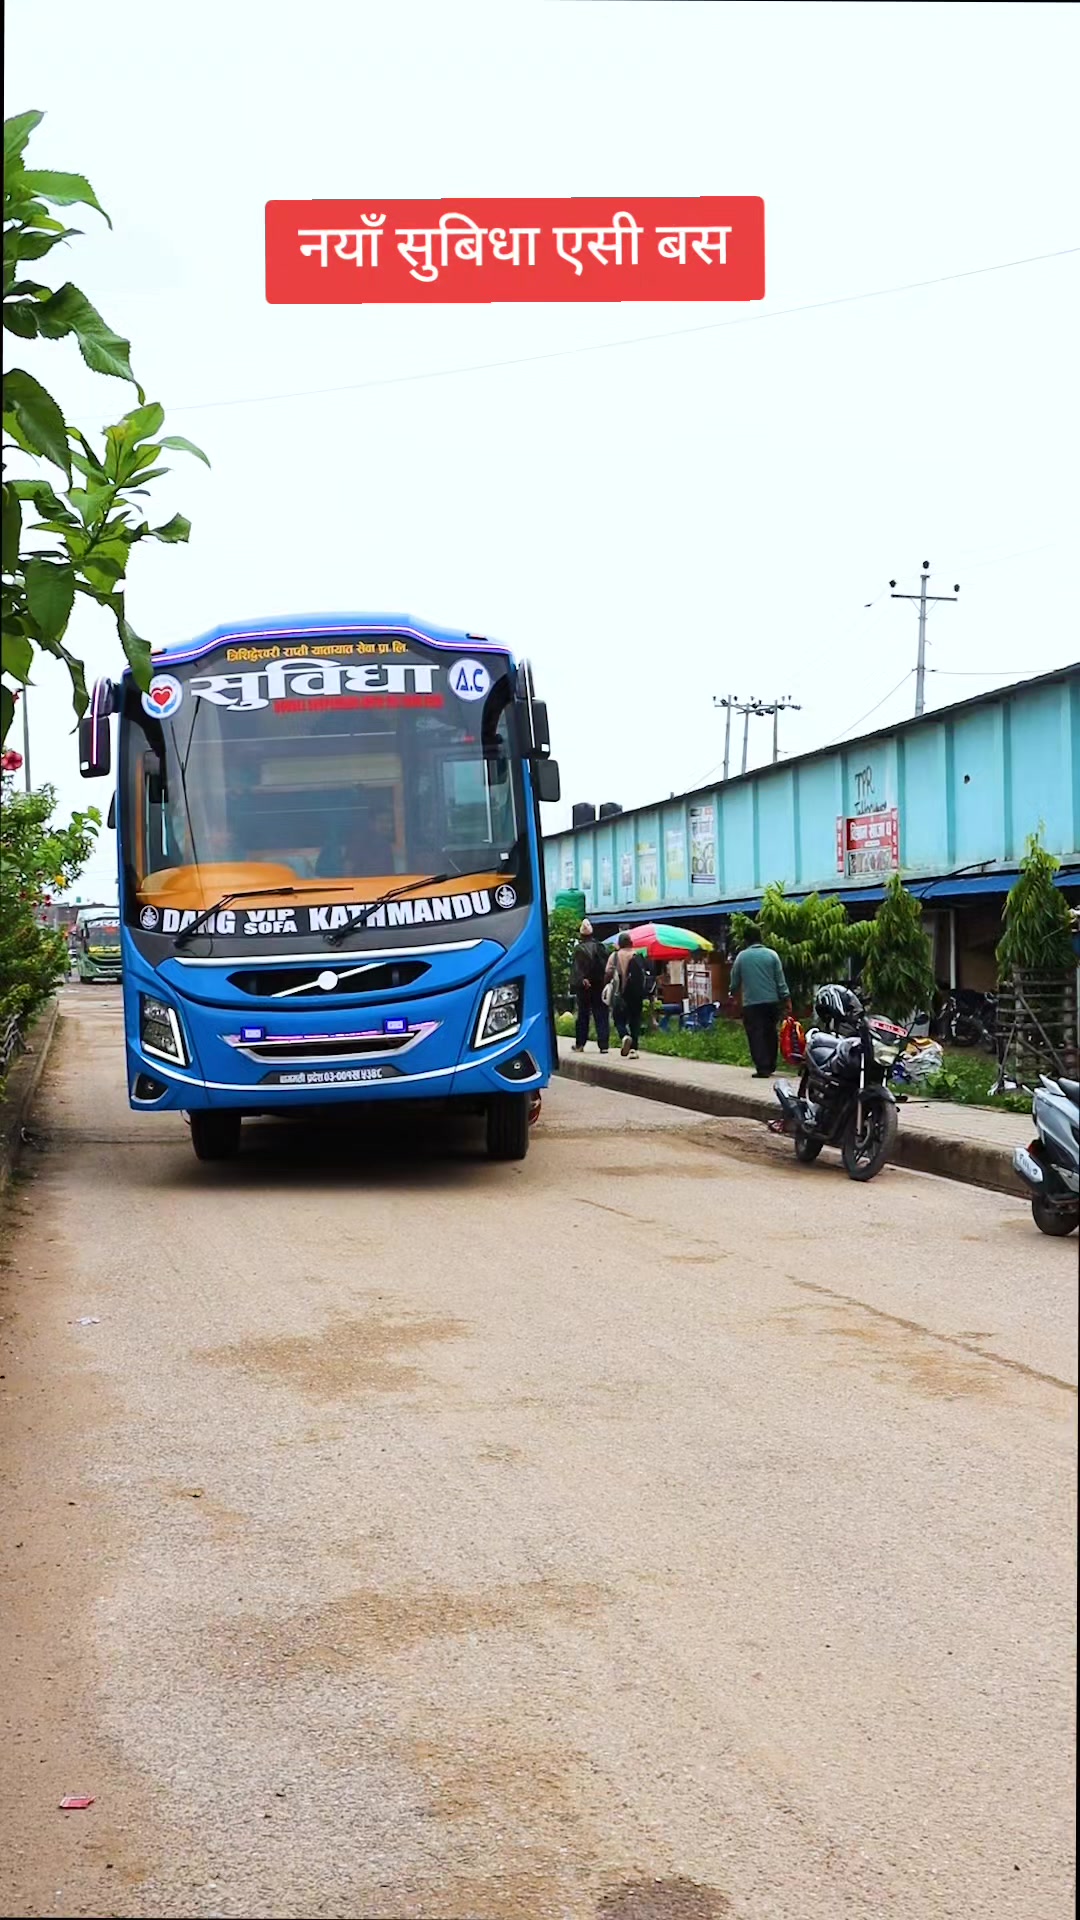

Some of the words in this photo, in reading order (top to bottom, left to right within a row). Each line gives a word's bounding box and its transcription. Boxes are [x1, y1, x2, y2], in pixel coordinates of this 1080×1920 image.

[311, 644, 353, 655] यातायात
[356, 640, 375, 654] सेवा
[189, 658, 440, 712] सुविधा
[246, 908, 296, 922] VIP
[308, 890, 492, 932] KATHMANDU
[243, 920, 298, 935] SOFA
